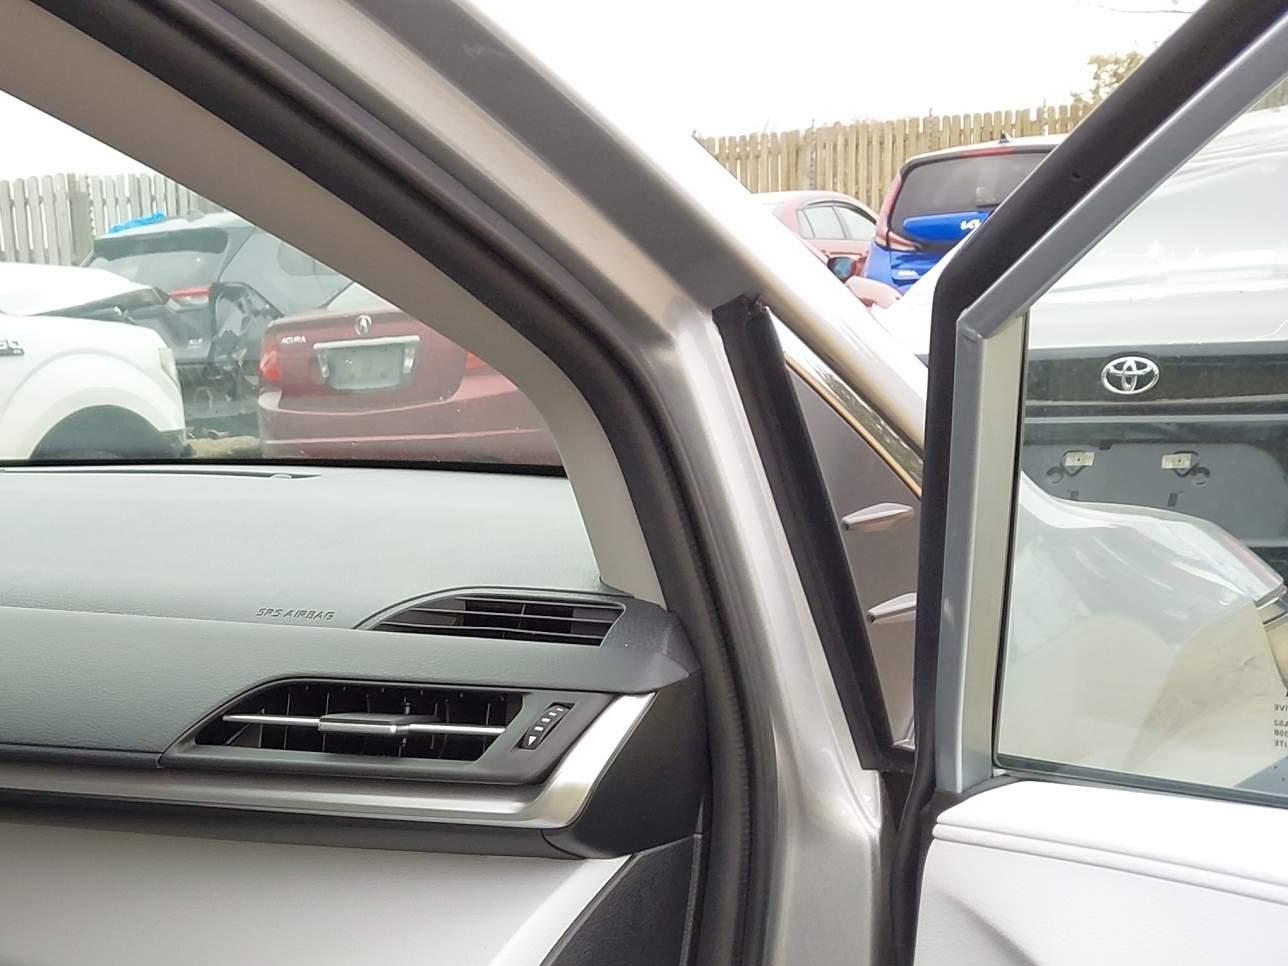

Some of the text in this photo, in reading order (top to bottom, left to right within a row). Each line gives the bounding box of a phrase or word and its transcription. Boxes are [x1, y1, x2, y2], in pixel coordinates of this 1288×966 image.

[280, 335, 307, 345] ACURA
[256, 608, 335, 620] SRS AIRBAG
